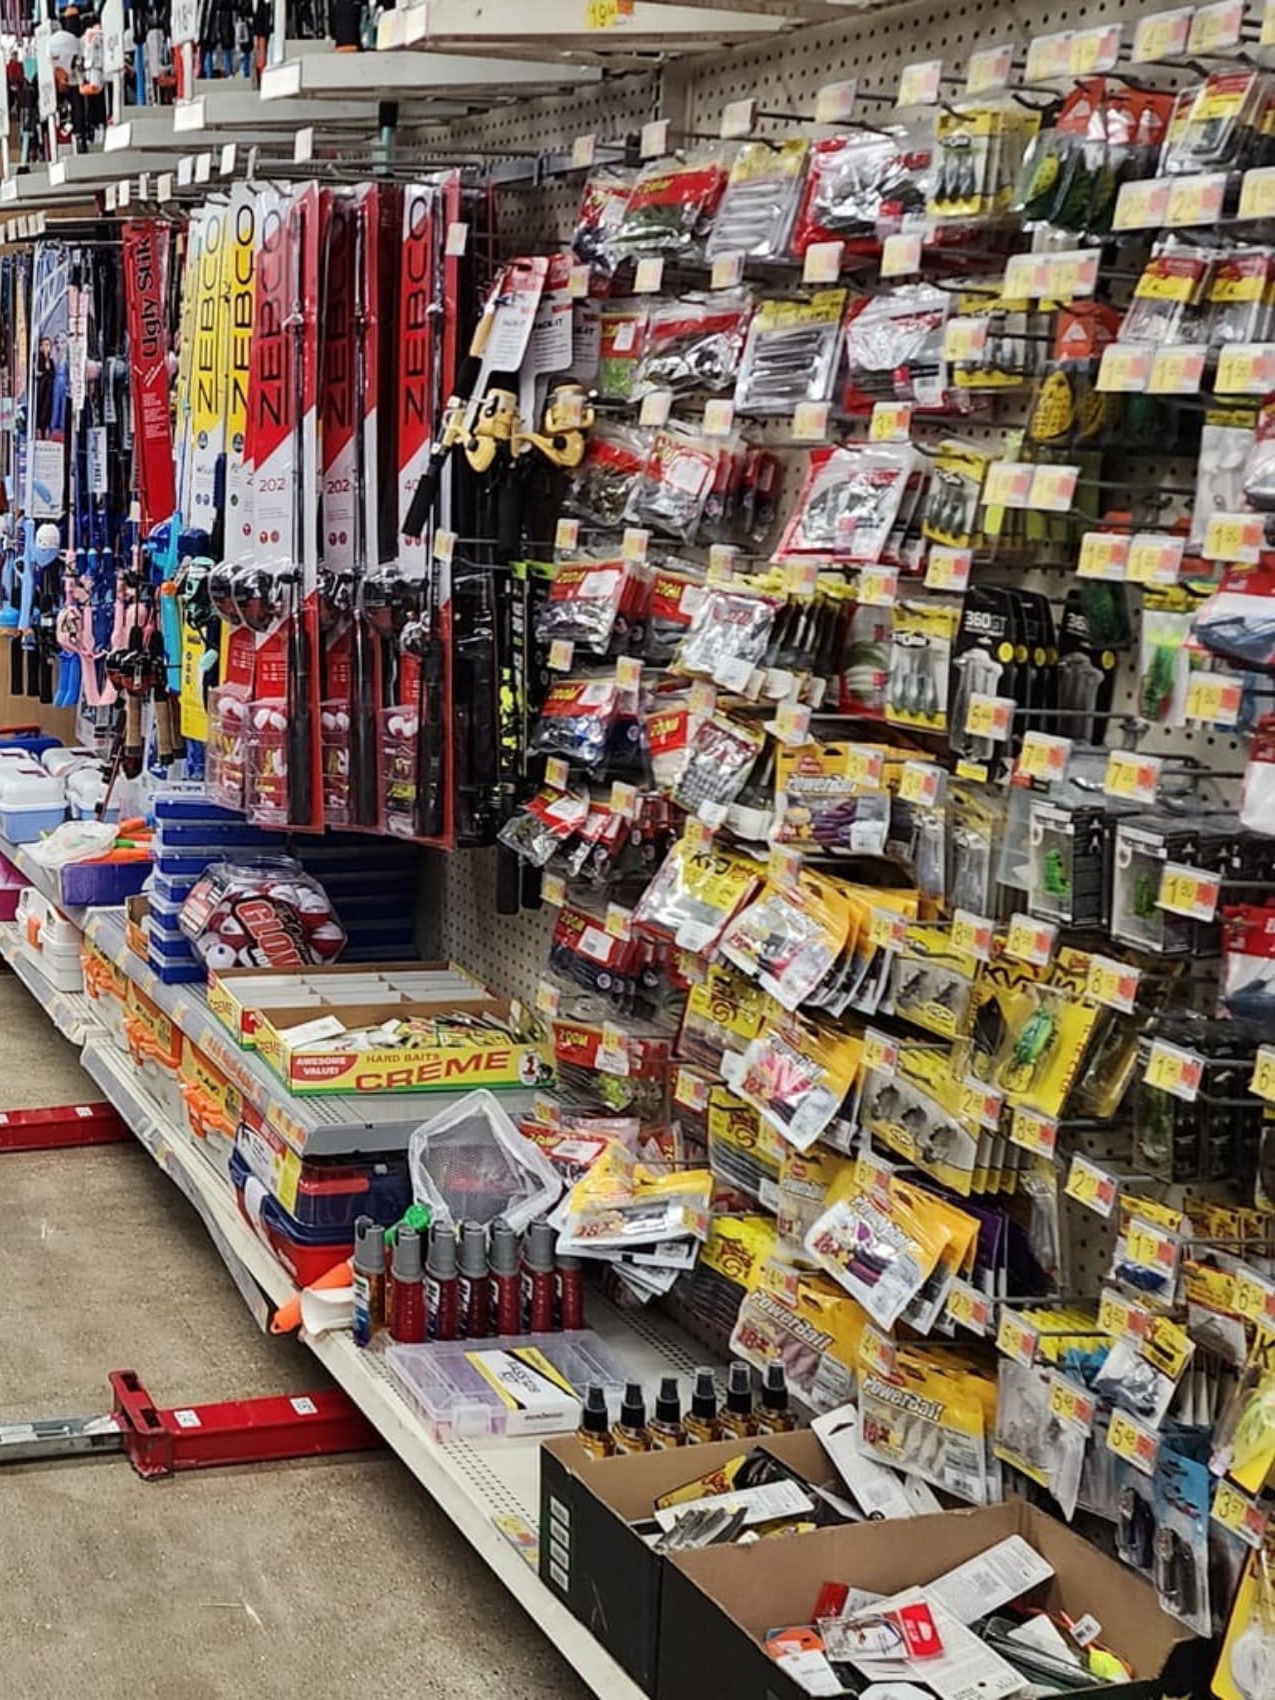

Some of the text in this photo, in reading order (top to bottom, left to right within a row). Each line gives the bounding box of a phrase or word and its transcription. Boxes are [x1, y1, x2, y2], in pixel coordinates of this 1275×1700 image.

[198, 215, 221, 415] ZEBCO
[232, 204, 255, 415] ZEBCO
[259, 210, 283, 428] ZEBCO
[405, 196, 428, 426] ZEBCO
[259, 477, 286, 492] 202
[327, 479, 351, 494] 202
[354, 1051, 511, 1092] CREME
[366, 1052, 440, 1064] HARD BAITS
